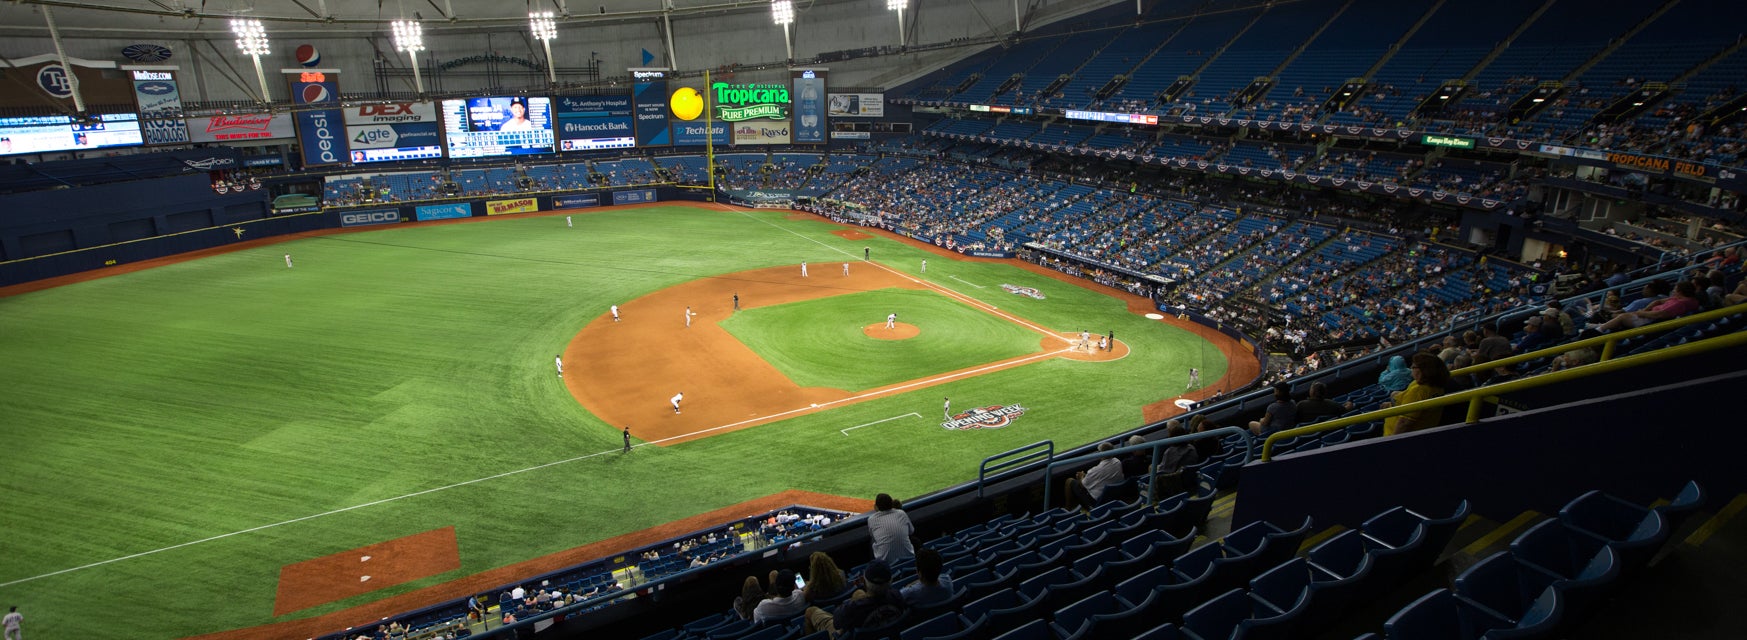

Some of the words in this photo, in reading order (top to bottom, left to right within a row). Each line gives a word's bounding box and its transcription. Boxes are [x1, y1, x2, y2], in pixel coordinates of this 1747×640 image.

[634, 71, 663, 79] Spectrum
[712, 82, 789, 106] Tropicana
[359, 102, 414, 117] DEX
[580, 100, 605, 108] Anthony's
[606, 99, 627, 108] Hospital
[373, 114, 421, 122] imaging
[638, 113, 664, 121] Spectrum
[722, 109, 743, 119] PURE
[744, 105, 780, 117] PREMIUM
[213, 115, 271, 127] Budweiser
[574, 123, 608, 131] Hancock
[608, 122, 629, 130] Bank
[146, 128, 188, 143] RADIOLOGY
[310, 114, 338, 162] pepsi
[367, 129, 390, 142] gte
[761, 127, 781, 138] Rays
[781, 127, 788, 136] 6
[212, 158, 234, 166] PORCH
[1606, 152, 1669, 170] TROPICANA
[1675, 162, 1705, 177] FIELD
[343, 212, 398, 224] GEICO
[421, 207, 452, 217] Sagicor
[942, 411, 993, 430] OPENING
[990, 403, 1021, 417] WEEK
